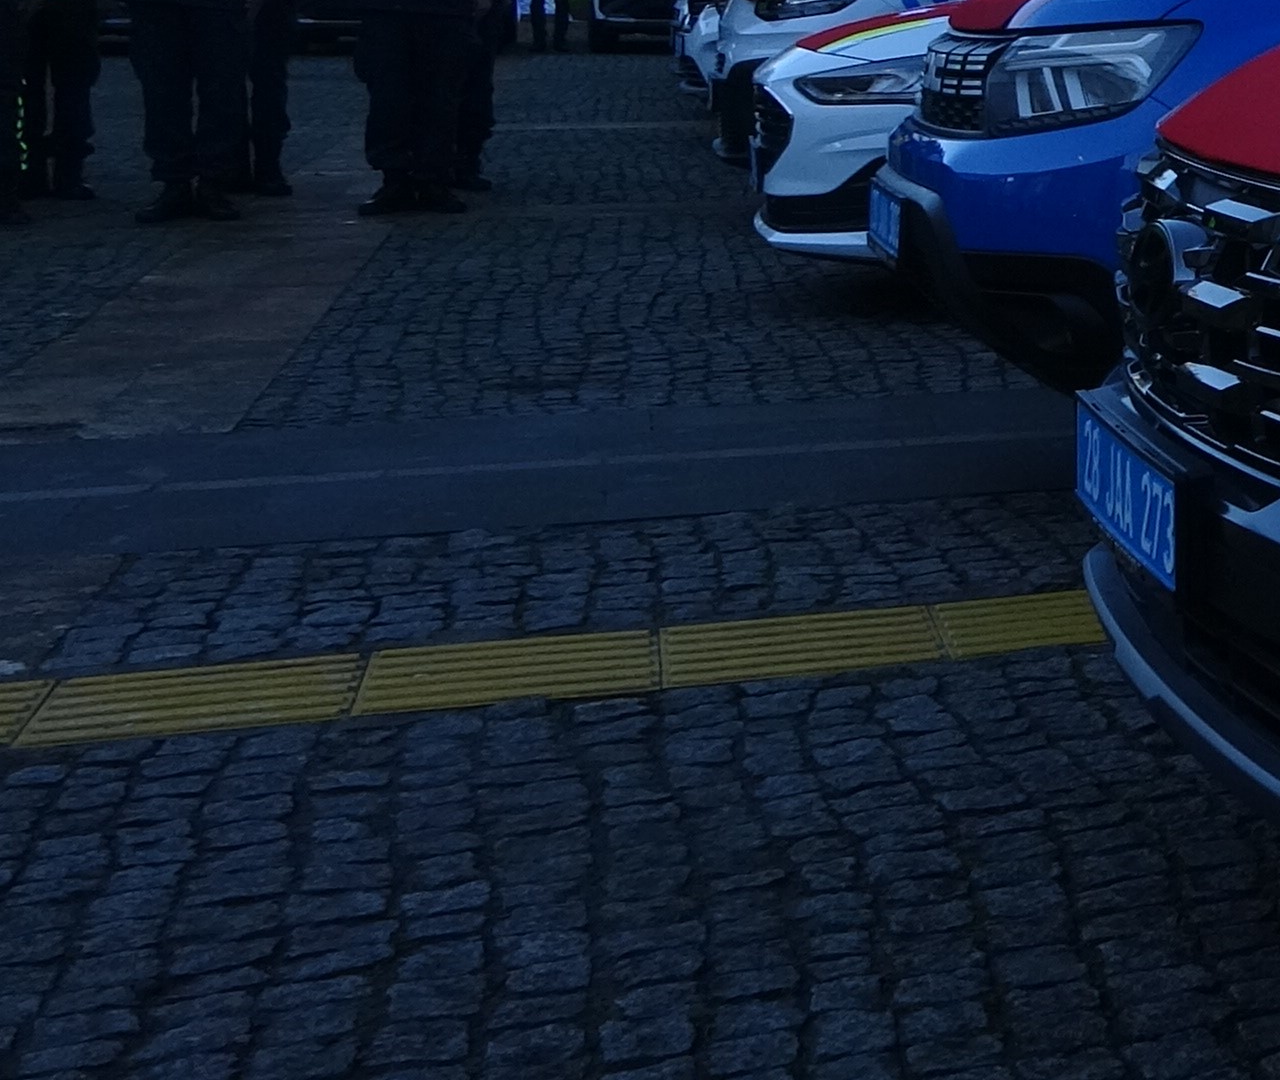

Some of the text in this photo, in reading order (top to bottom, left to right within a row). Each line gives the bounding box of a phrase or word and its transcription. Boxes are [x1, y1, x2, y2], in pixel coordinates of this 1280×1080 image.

[1084, 420, 1175, 574] 28 JAA 273
